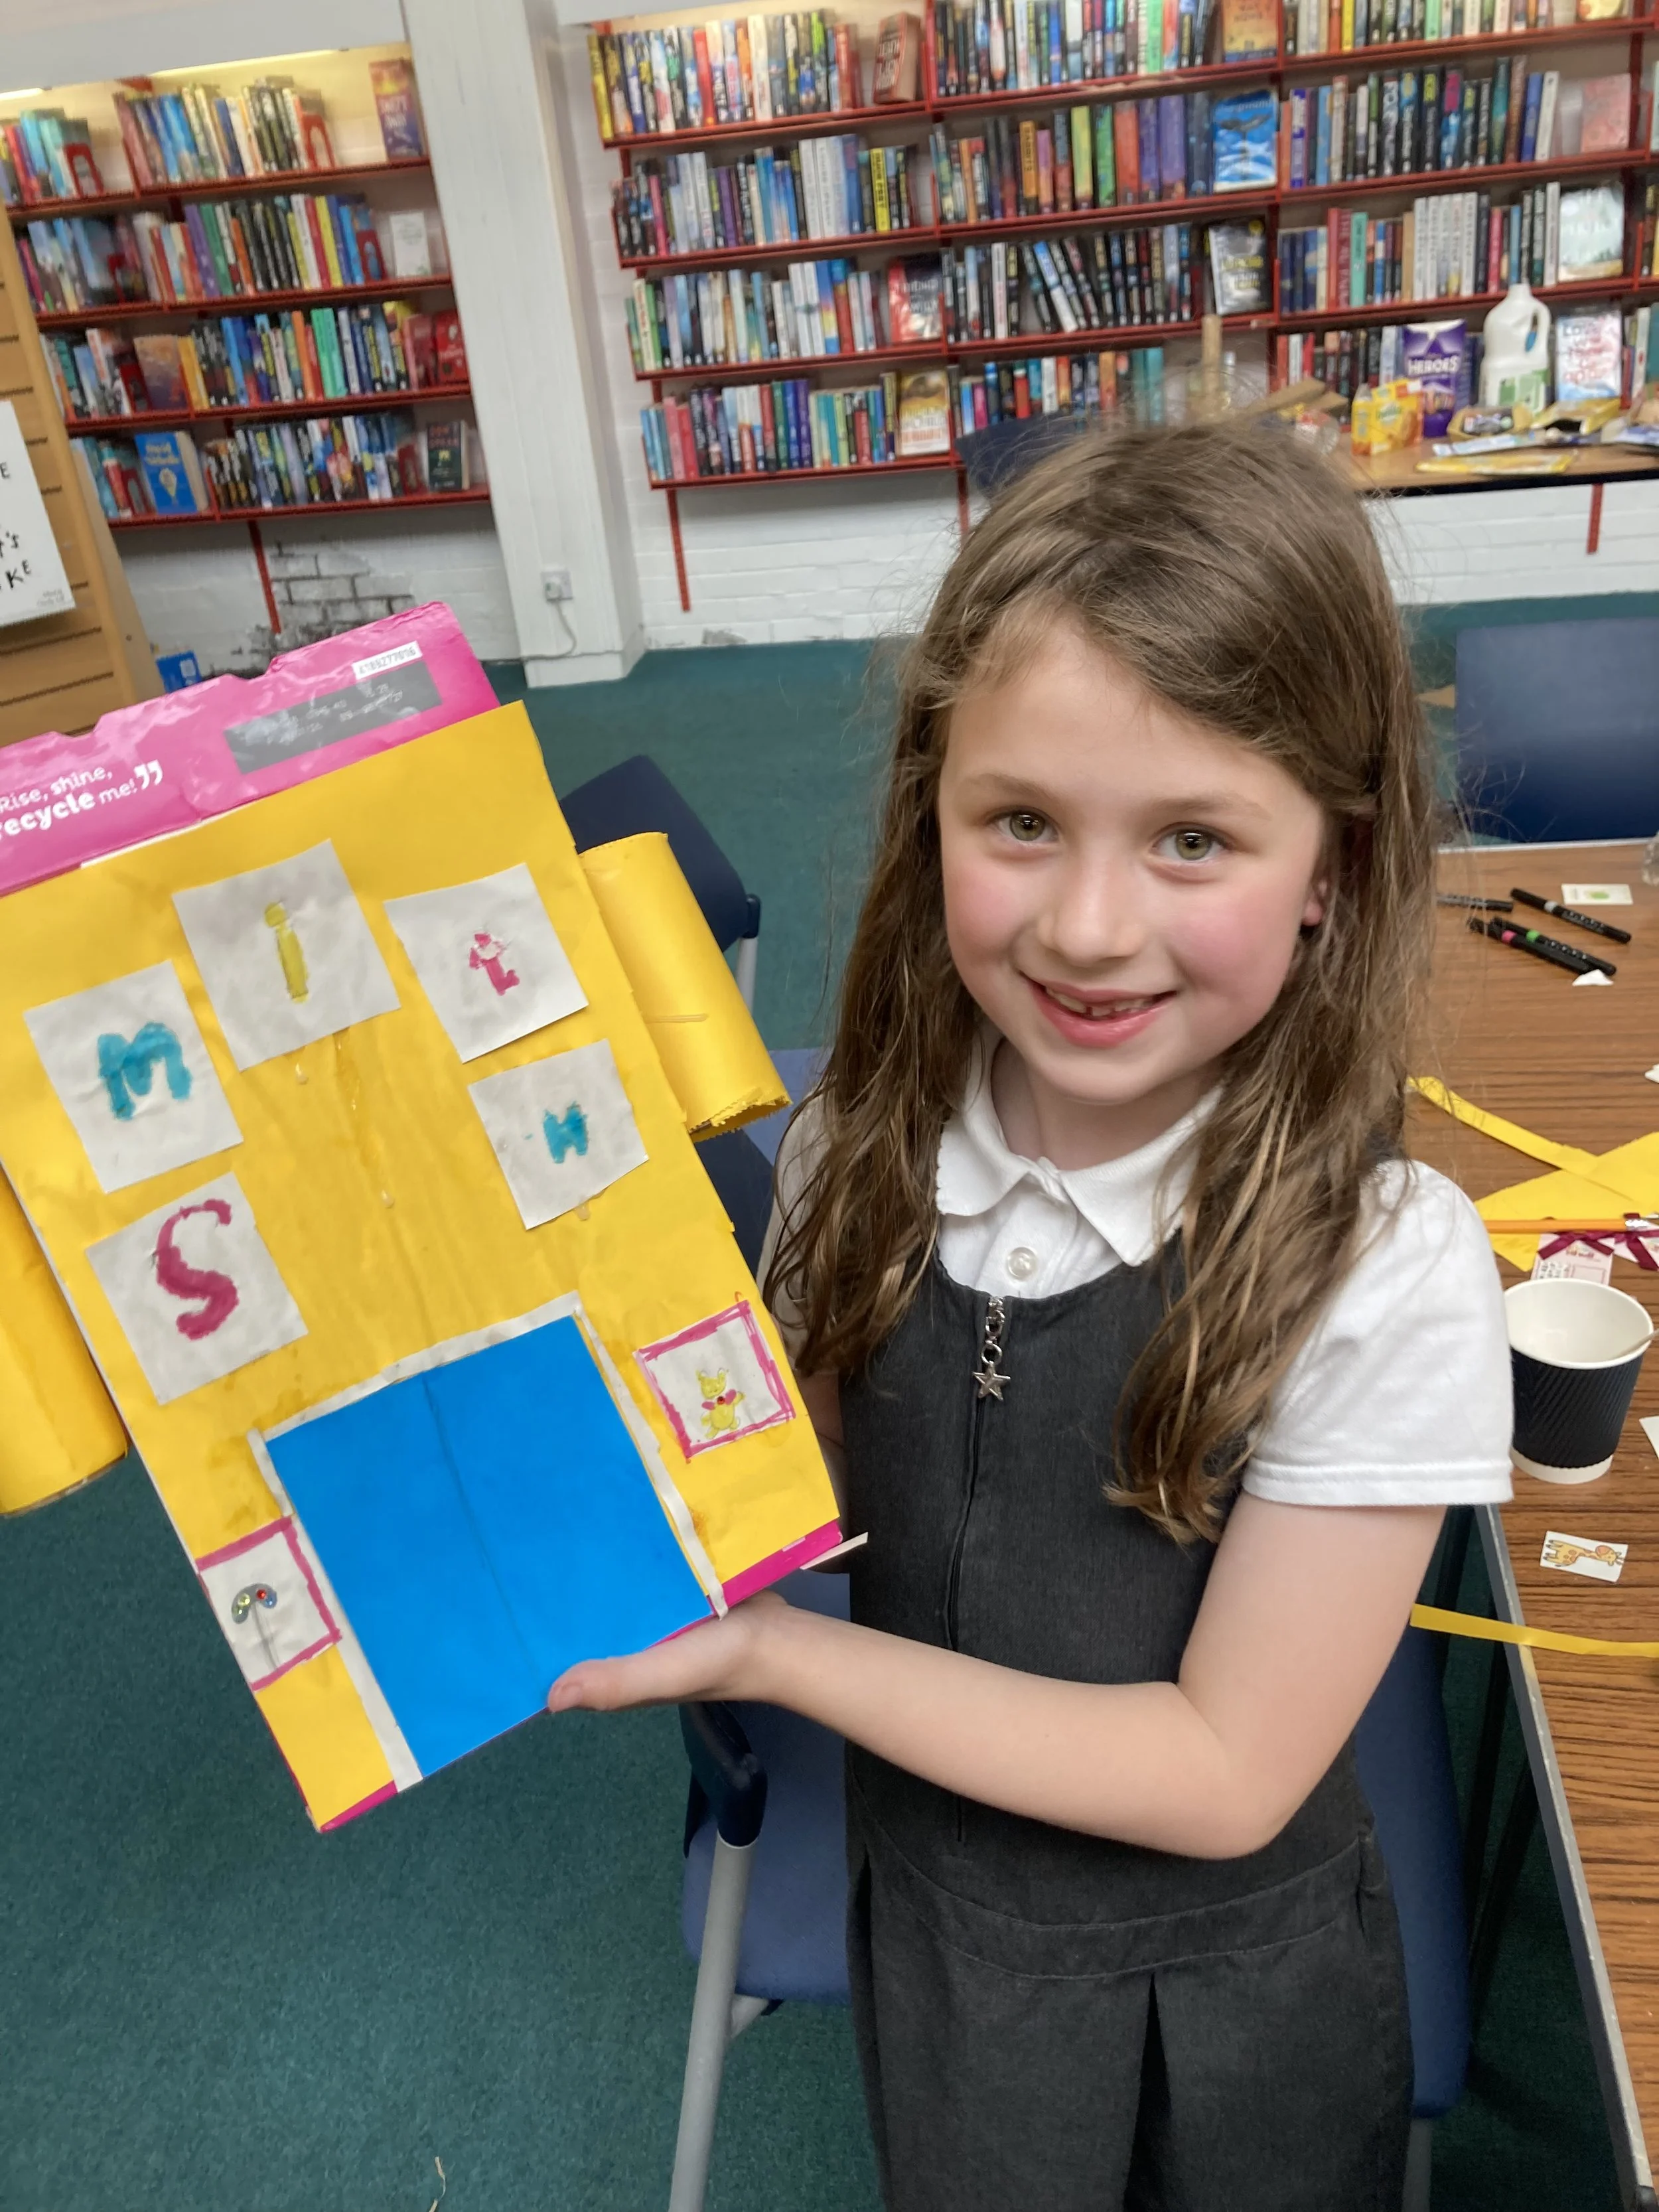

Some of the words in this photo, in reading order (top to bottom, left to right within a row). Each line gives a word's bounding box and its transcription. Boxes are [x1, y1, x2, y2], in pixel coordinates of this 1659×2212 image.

[1407, 355, 1459, 376] HEROES
[50, 767, 113, 796] shine,
[0, 792, 96, 842] ecycle
